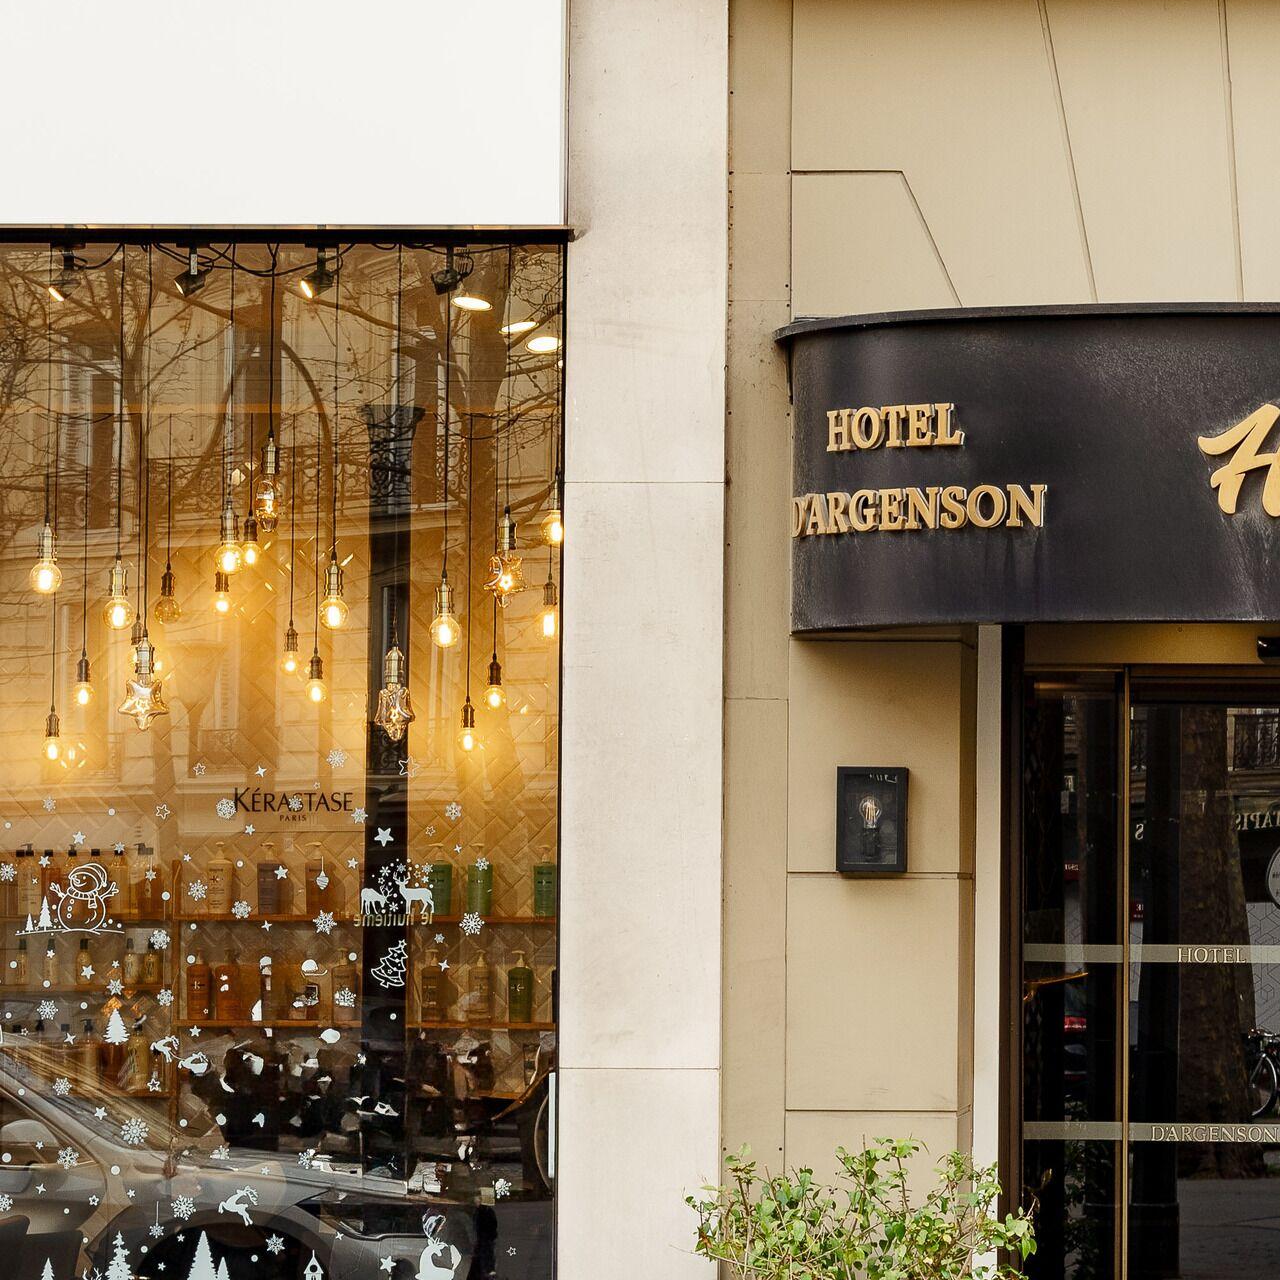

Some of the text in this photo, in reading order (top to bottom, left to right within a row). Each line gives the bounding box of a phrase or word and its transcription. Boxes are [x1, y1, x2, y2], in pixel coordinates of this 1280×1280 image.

[826, 402, 966, 452] HOTEL
[791, 483, 1048, 538] D'ARGENSON
[279, 814, 307, 822] PARIS
[1177, 947, 1248, 964] HOTEL
[1150, 1125, 1279, 1143] D'ARGENSON
